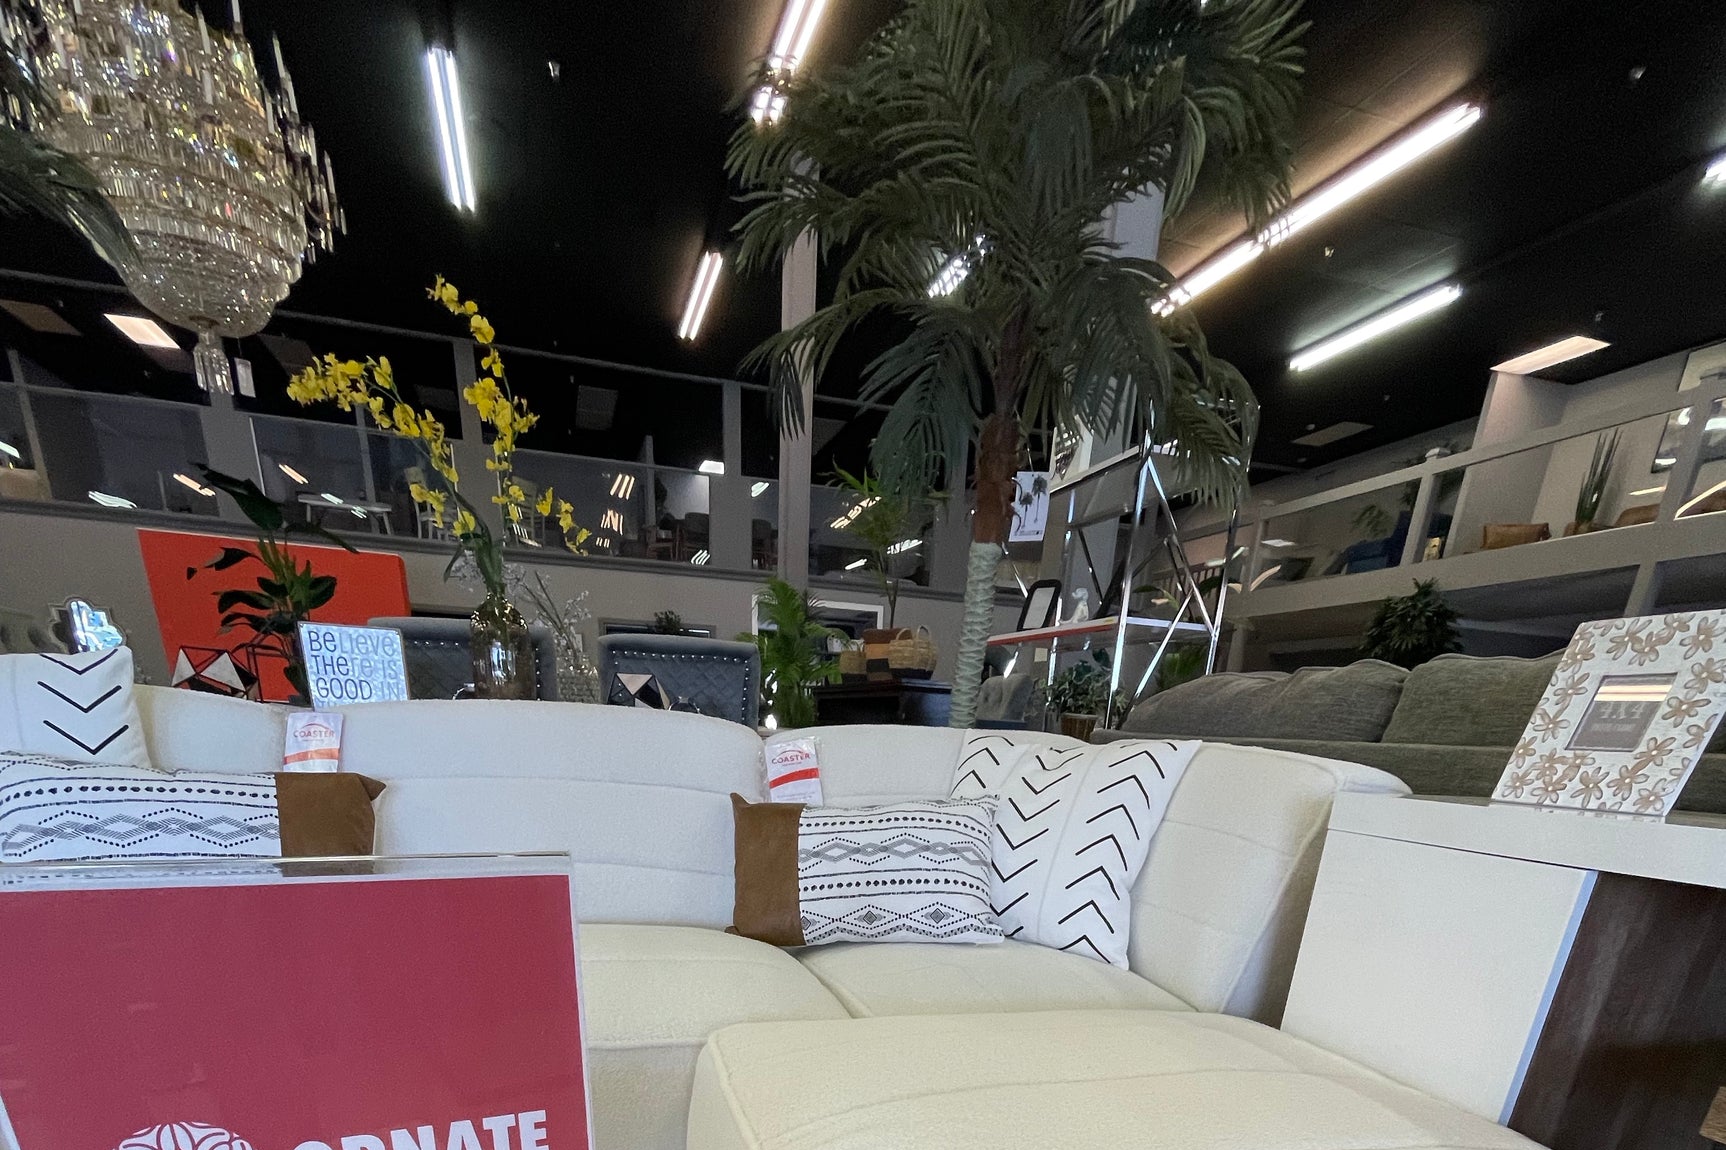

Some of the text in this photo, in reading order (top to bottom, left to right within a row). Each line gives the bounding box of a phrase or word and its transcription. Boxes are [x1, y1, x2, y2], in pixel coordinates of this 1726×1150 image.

[316, 677, 372, 700] GOOD
[293, 730, 336, 738] COASTER
[771, 752, 811, 765] COASTER
